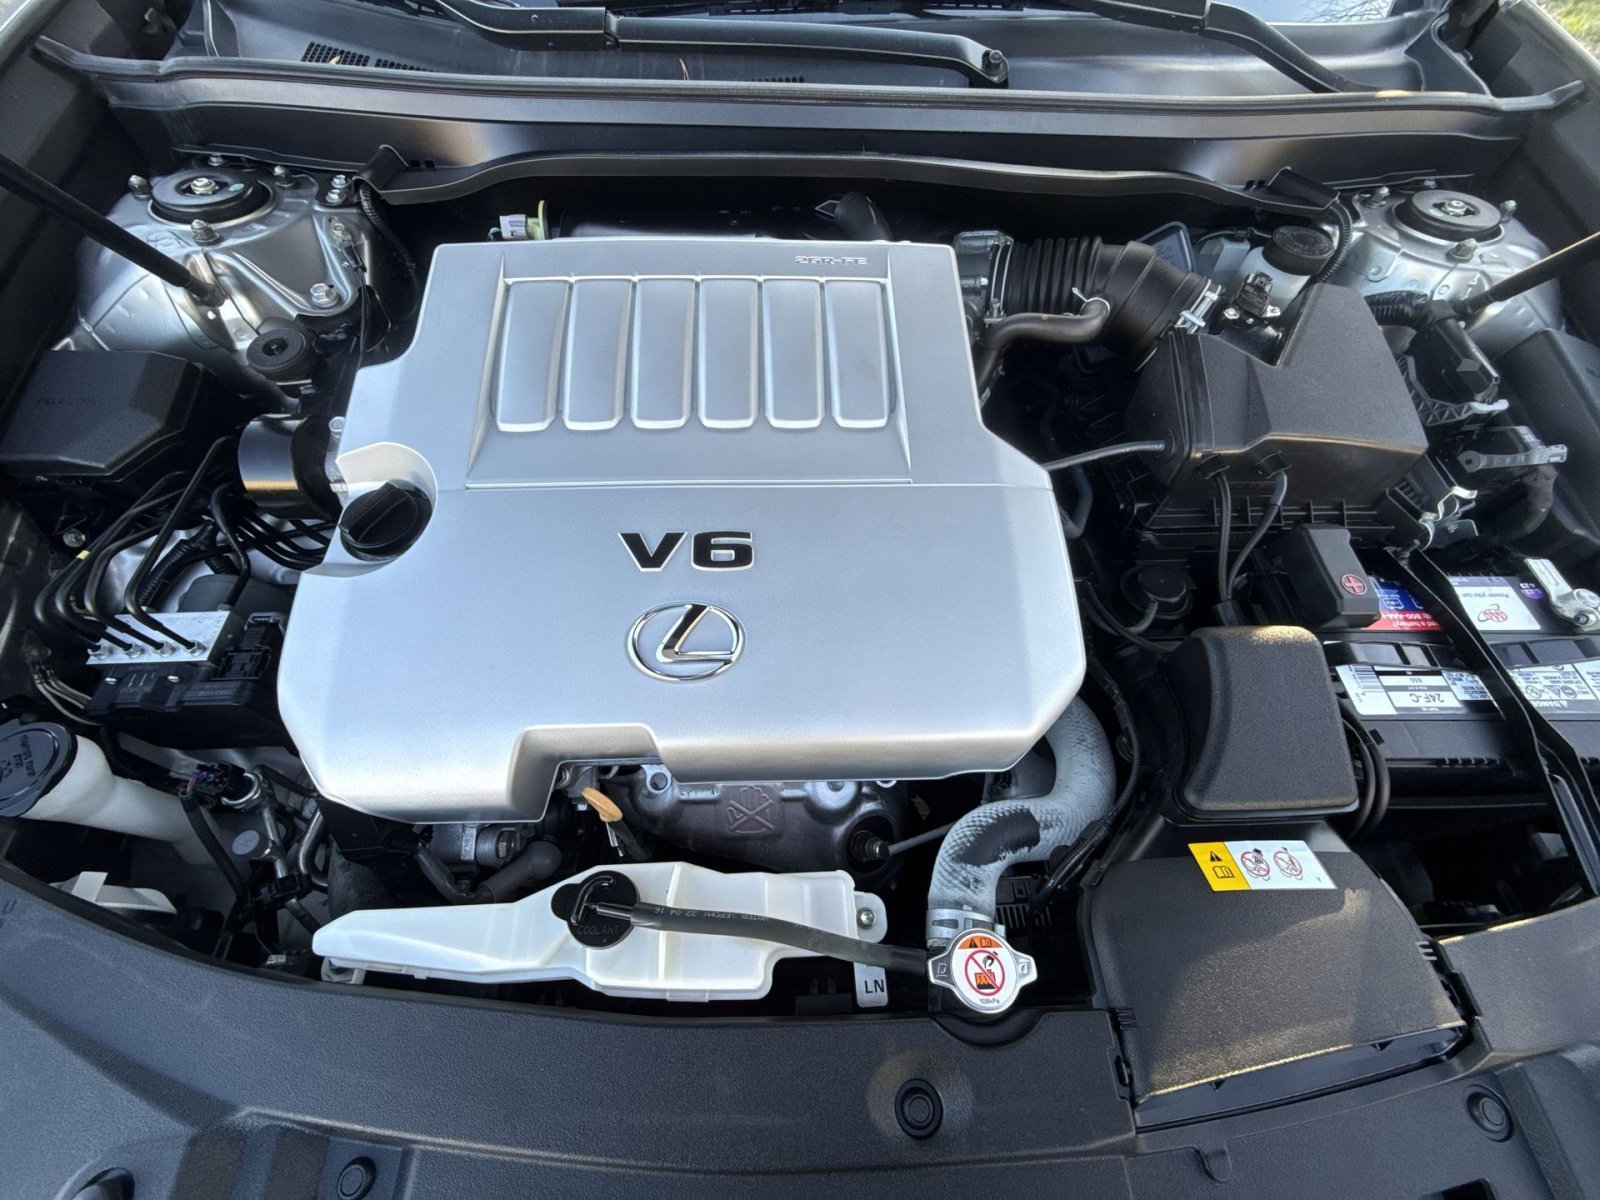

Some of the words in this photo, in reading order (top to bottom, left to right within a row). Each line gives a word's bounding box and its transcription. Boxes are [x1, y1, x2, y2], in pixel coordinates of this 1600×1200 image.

[793, 255, 869, 266] 2GR-FE
[617, 531, 755, 572] V6
[1409, 692, 1445, 703] 24F-C
[654, 906, 665, 915] 16
[670, 908, 682, 916] 04
[577, 924, 619, 936] COOLANT
[864, 979, 885, 994] LN
